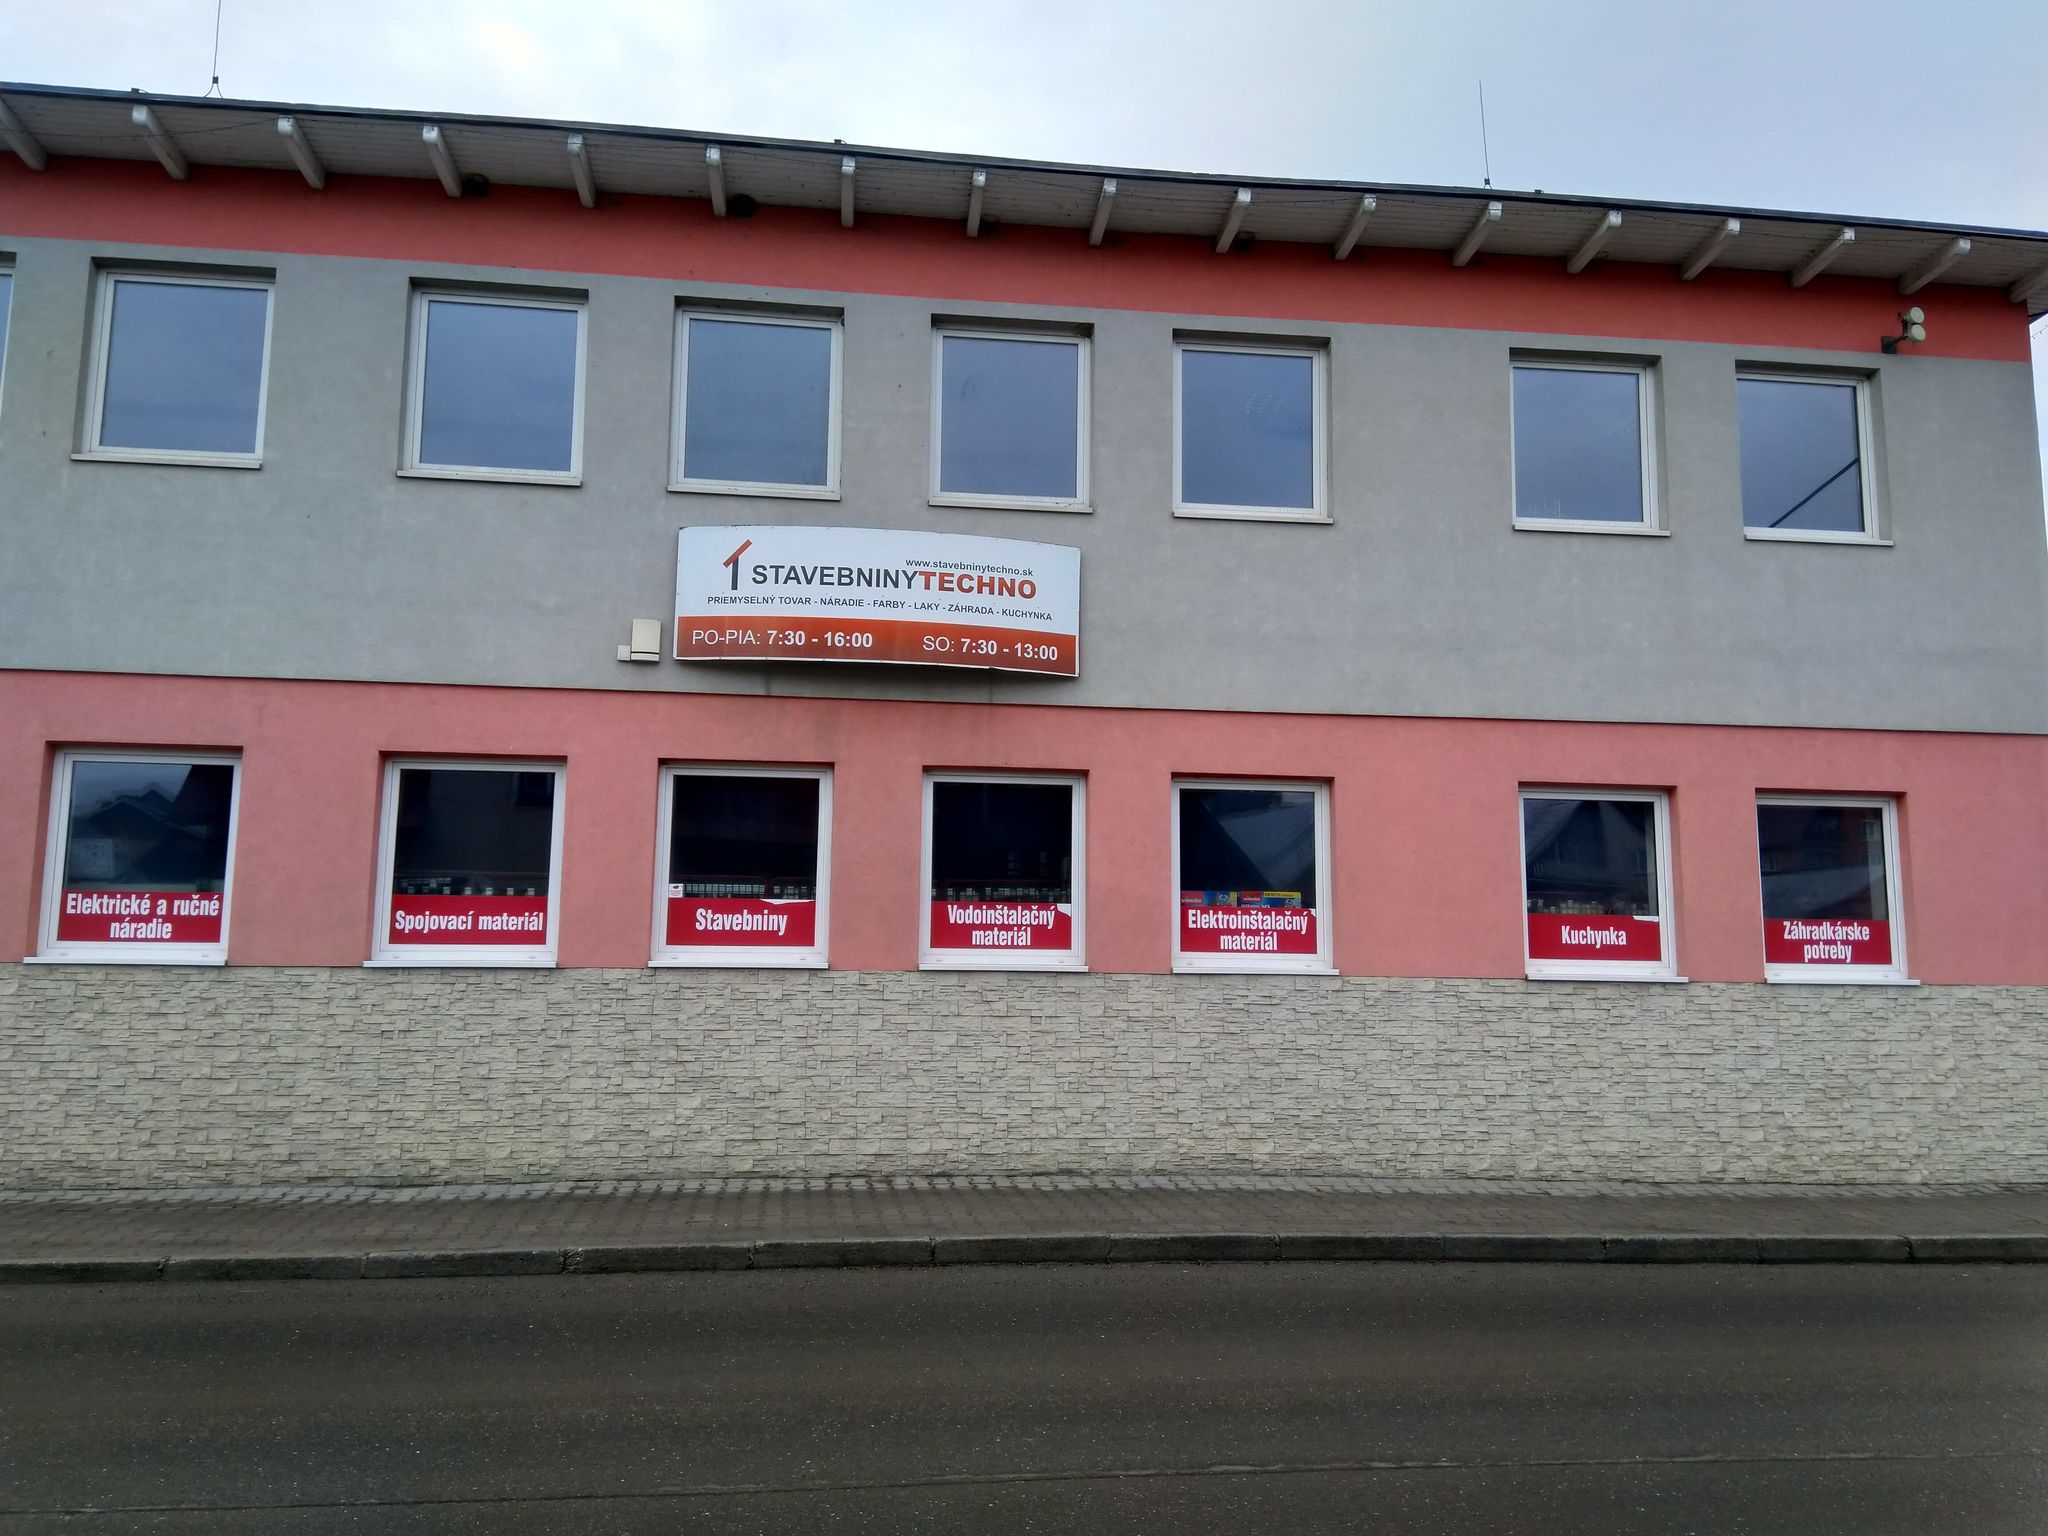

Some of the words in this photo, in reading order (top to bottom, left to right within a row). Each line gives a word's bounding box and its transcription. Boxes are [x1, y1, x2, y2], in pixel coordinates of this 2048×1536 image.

[905, 559, 1034, 577] www.stavebninytechno.sk
[751, 564, 1037, 599] STAVEBNINYTECHNO
[707, 594, 776, 605] PRIEMYSELNÝ
[779, 596, 812, 605] TOVAR
[820, 595, 865, 607] NÁRADIE
[873, 600, 906, 609] FARBY
[914, 602, 940, 611] LAKY
[948, 602, 994, 615] ZÁHRADA
[1001, 608, 1053, 621] KUCHYNKA
[692, 629, 761, 645] PO-PIA:
[767, 630, 806, 646] 7:30
[824, 631, 873, 648] 16:00
[922, 635, 955, 652] SO:
[960, 637, 998, 655] 7:30
[1014, 642, 1058, 661] 13:00
[66, 893, 151, 915] Elektrické
[156, 899, 167, 915] a
[173, 894, 219, 916] ručné
[109, 917, 172, 939] náradie
[395, 910, 474, 933] Spojovací
[478, 911, 544, 931] materiál
[695, 908, 788, 936] Stavebniny
[947, 904, 1056, 929] Vodoinštalačný
[1187, 909, 1308, 935] Elektroinštalačný
[971, 926, 1031, 946] materiál
[1220, 931, 1278, 951] materiál
[1561, 925, 1627, 949] Kuchynka
[1783, 920, 1870, 940] Záhradkárske
[1803, 940, 1852, 963] potreby
